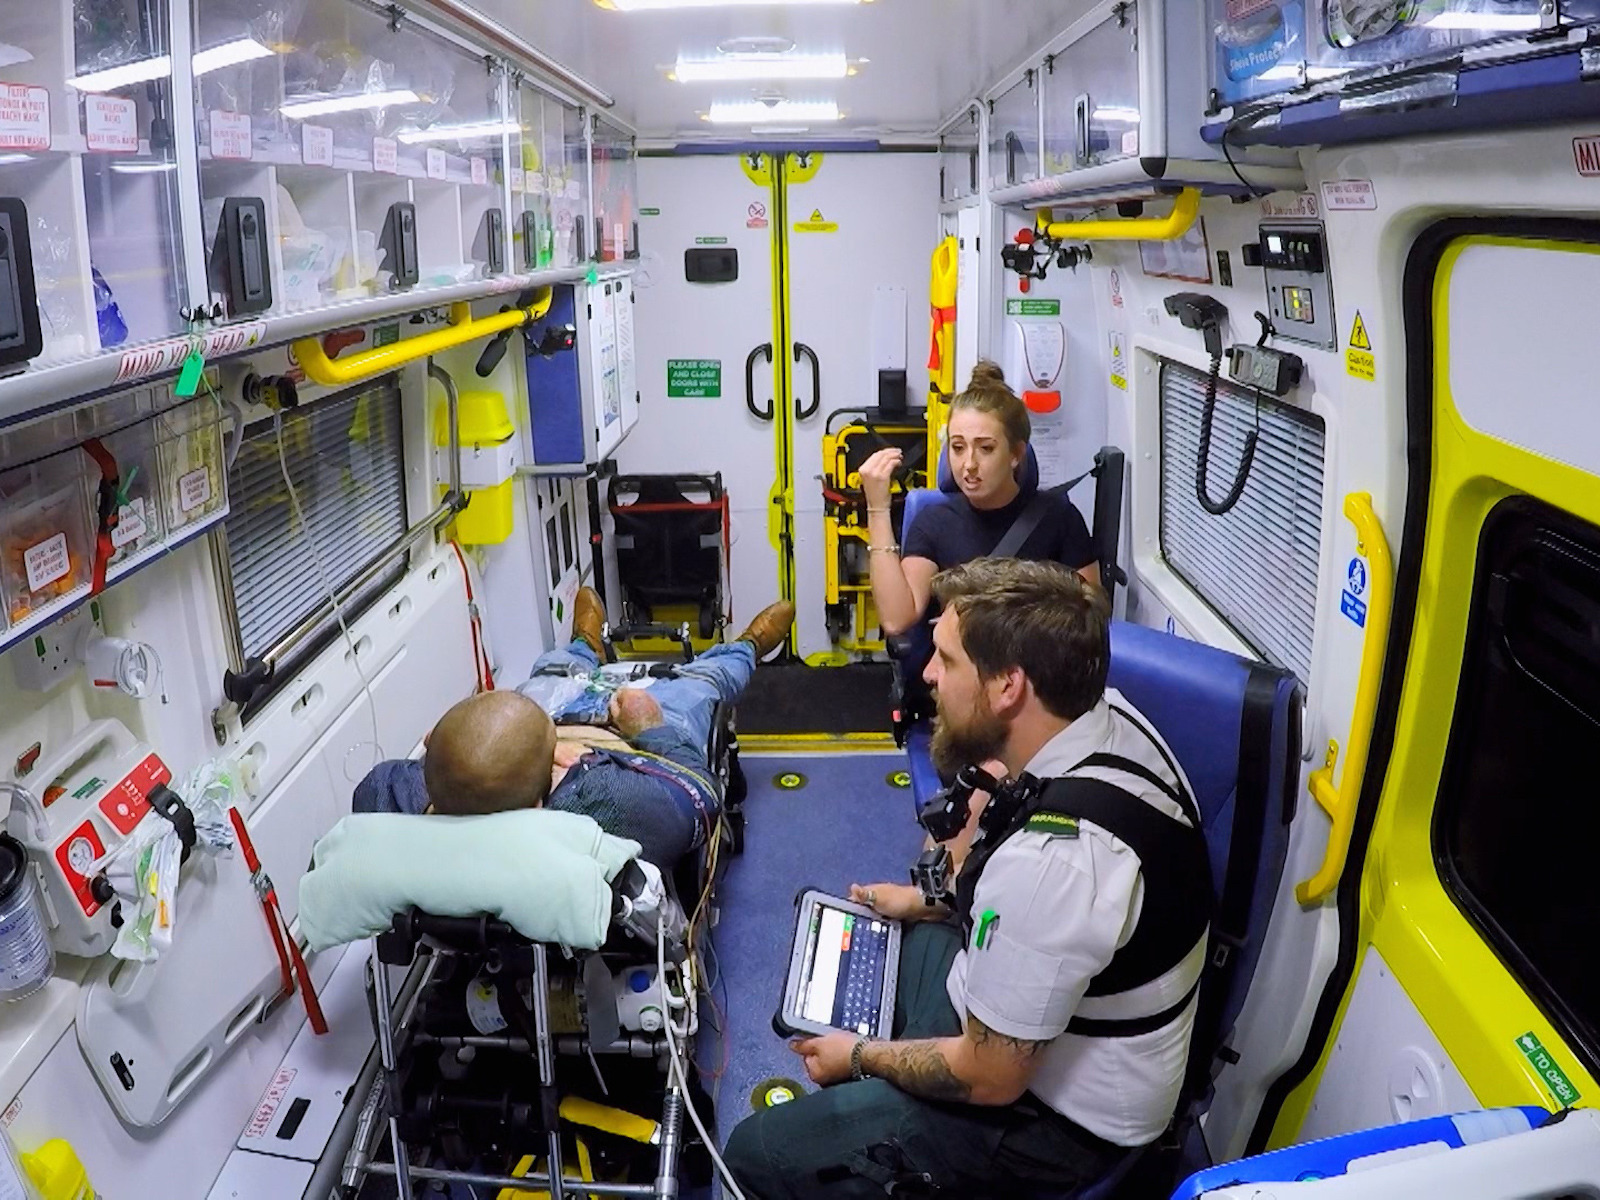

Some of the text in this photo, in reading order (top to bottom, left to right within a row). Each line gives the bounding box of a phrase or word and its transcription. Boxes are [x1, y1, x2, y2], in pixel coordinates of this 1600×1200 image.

[1578, 141, 1600, 171] MI
[118, 330, 246, 379] MIND YOR HEAD
[668, 361, 720, 369] PLEASE OPEN
[672, 370, 717, 378] AND CLOSE
[671, 379, 698, 387] DOORS
[684, 388, 705, 396] CARE
[1534, 1052, 1551, 1069] TO
[1545, 1069, 1574, 1100] OPEN
